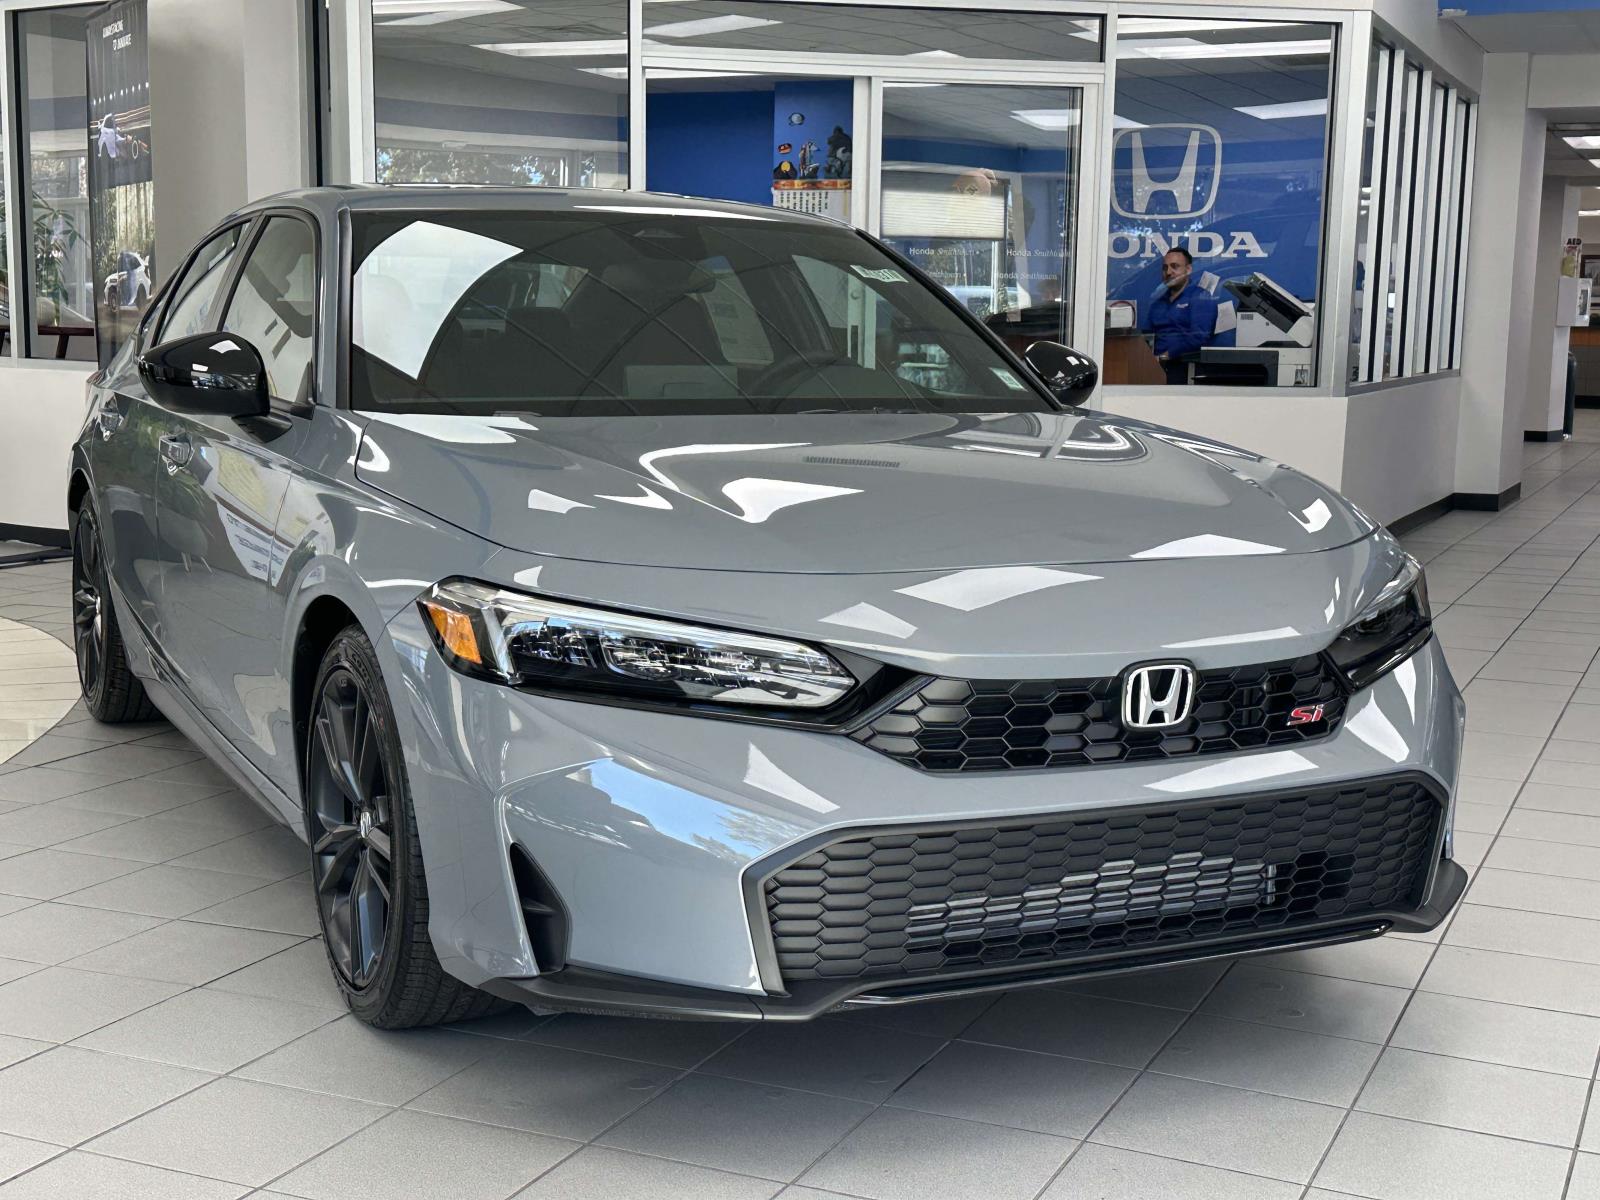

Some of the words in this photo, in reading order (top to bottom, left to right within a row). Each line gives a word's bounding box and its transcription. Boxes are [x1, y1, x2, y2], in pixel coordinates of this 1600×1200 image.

[1108, 231, 1268, 258] ONDA
[909, 247, 934, 256] Honda
[1006, 249, 1032, 257] Honda
[928, 268, 962, 278] mithtown
[998, 271, 1018, 280] onda
[1286, 704, 1325, 726] Si
